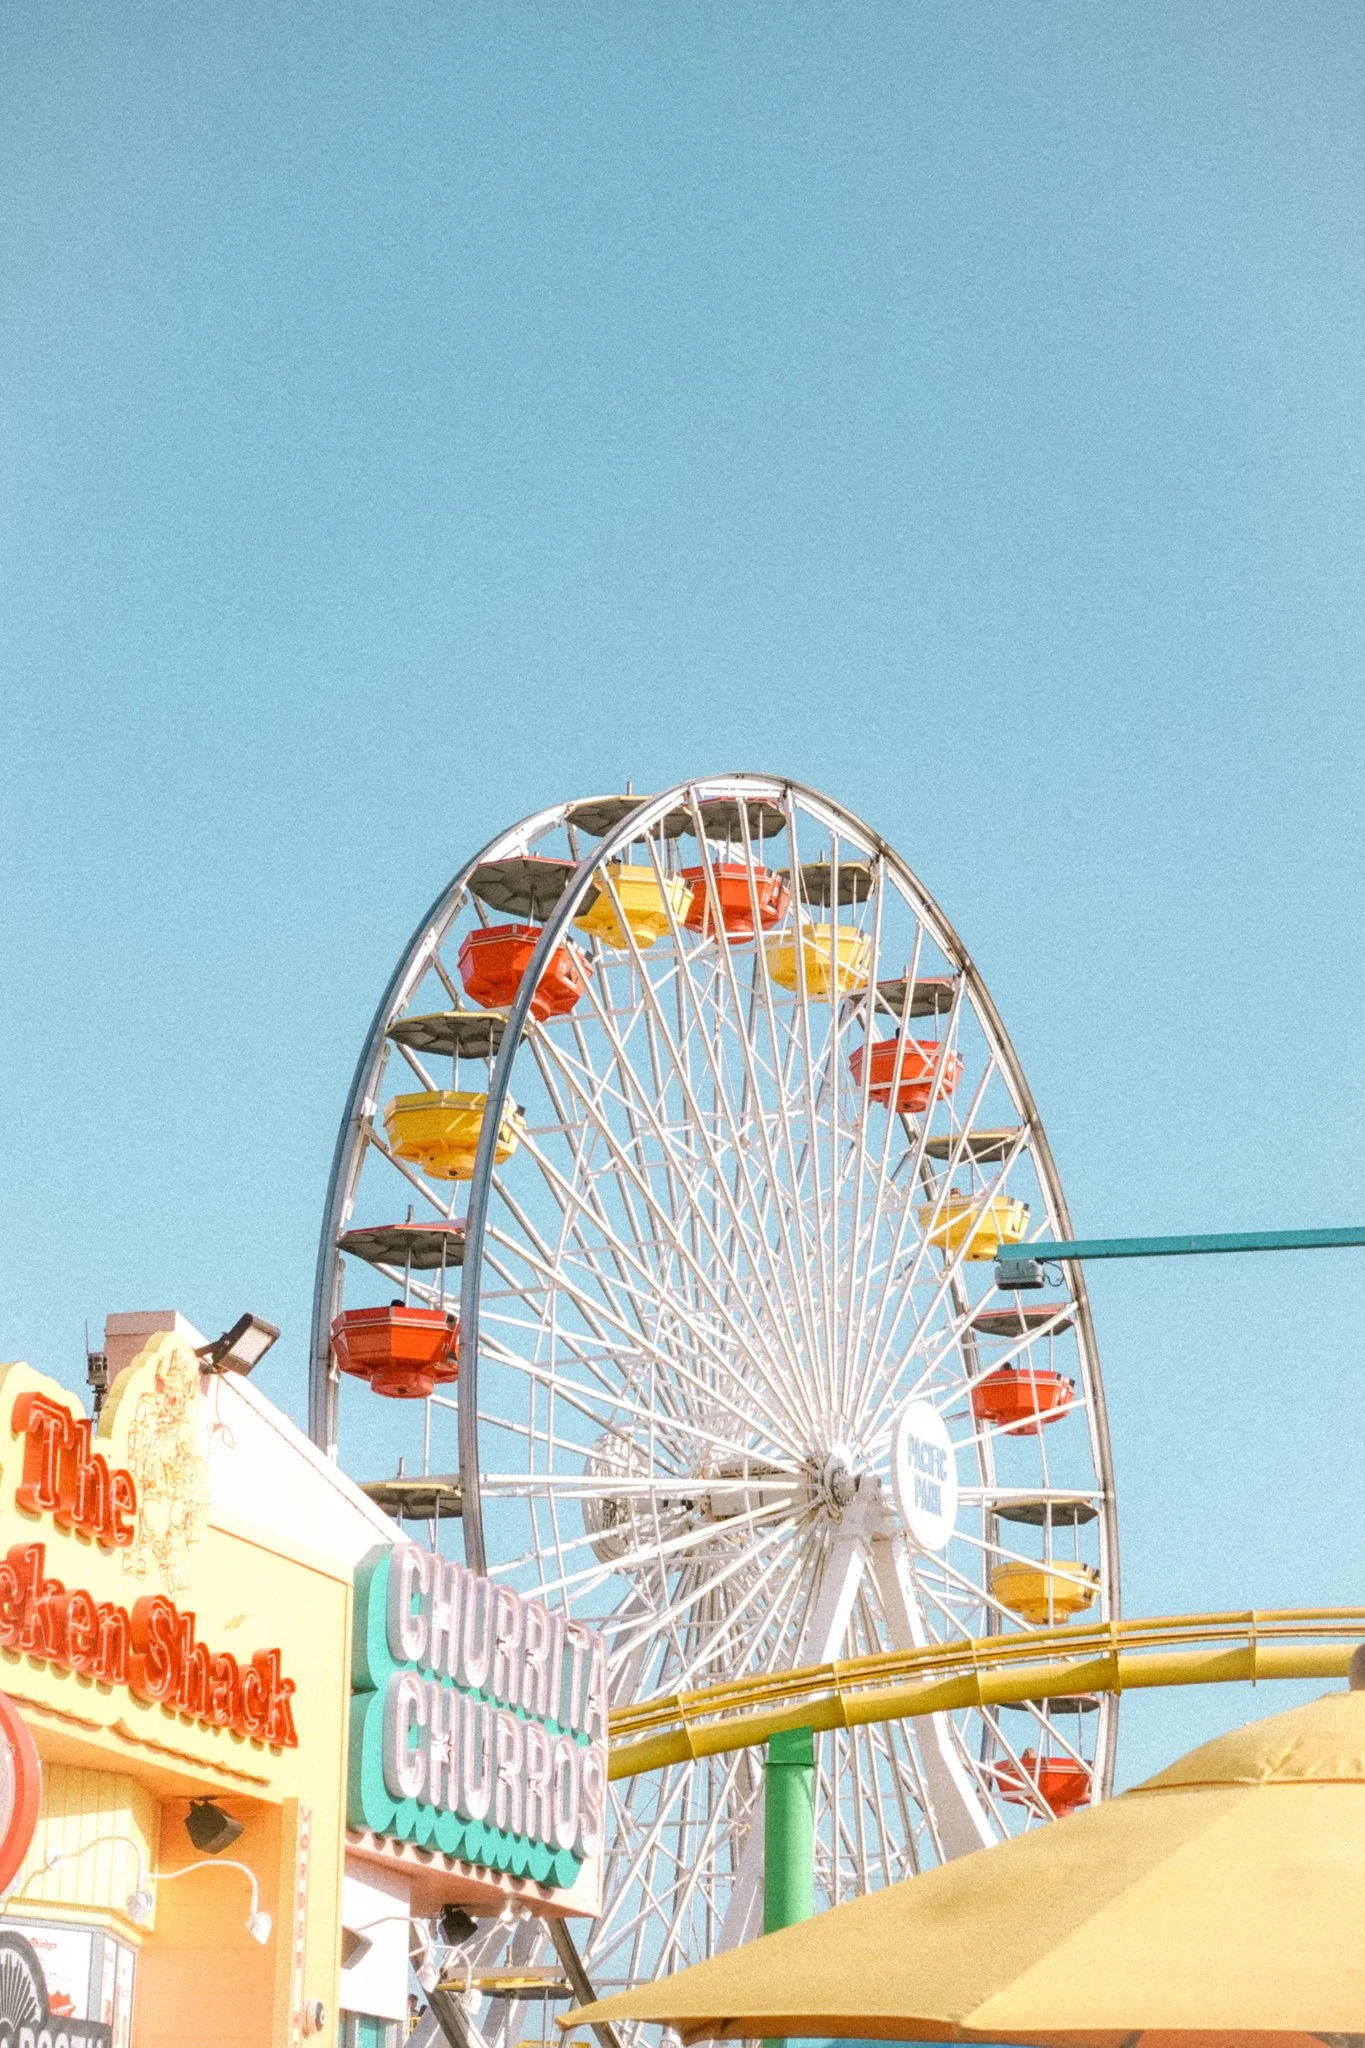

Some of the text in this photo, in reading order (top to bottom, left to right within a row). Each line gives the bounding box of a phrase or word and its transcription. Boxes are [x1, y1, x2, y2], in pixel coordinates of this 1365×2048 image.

[11, 1392, 137, 1547] The
[907, 1432, 948, 1482] PACIFIC
[129, 1595, 298, 1749] Shack
[383, 1670, 608, 1858] CHURROS
